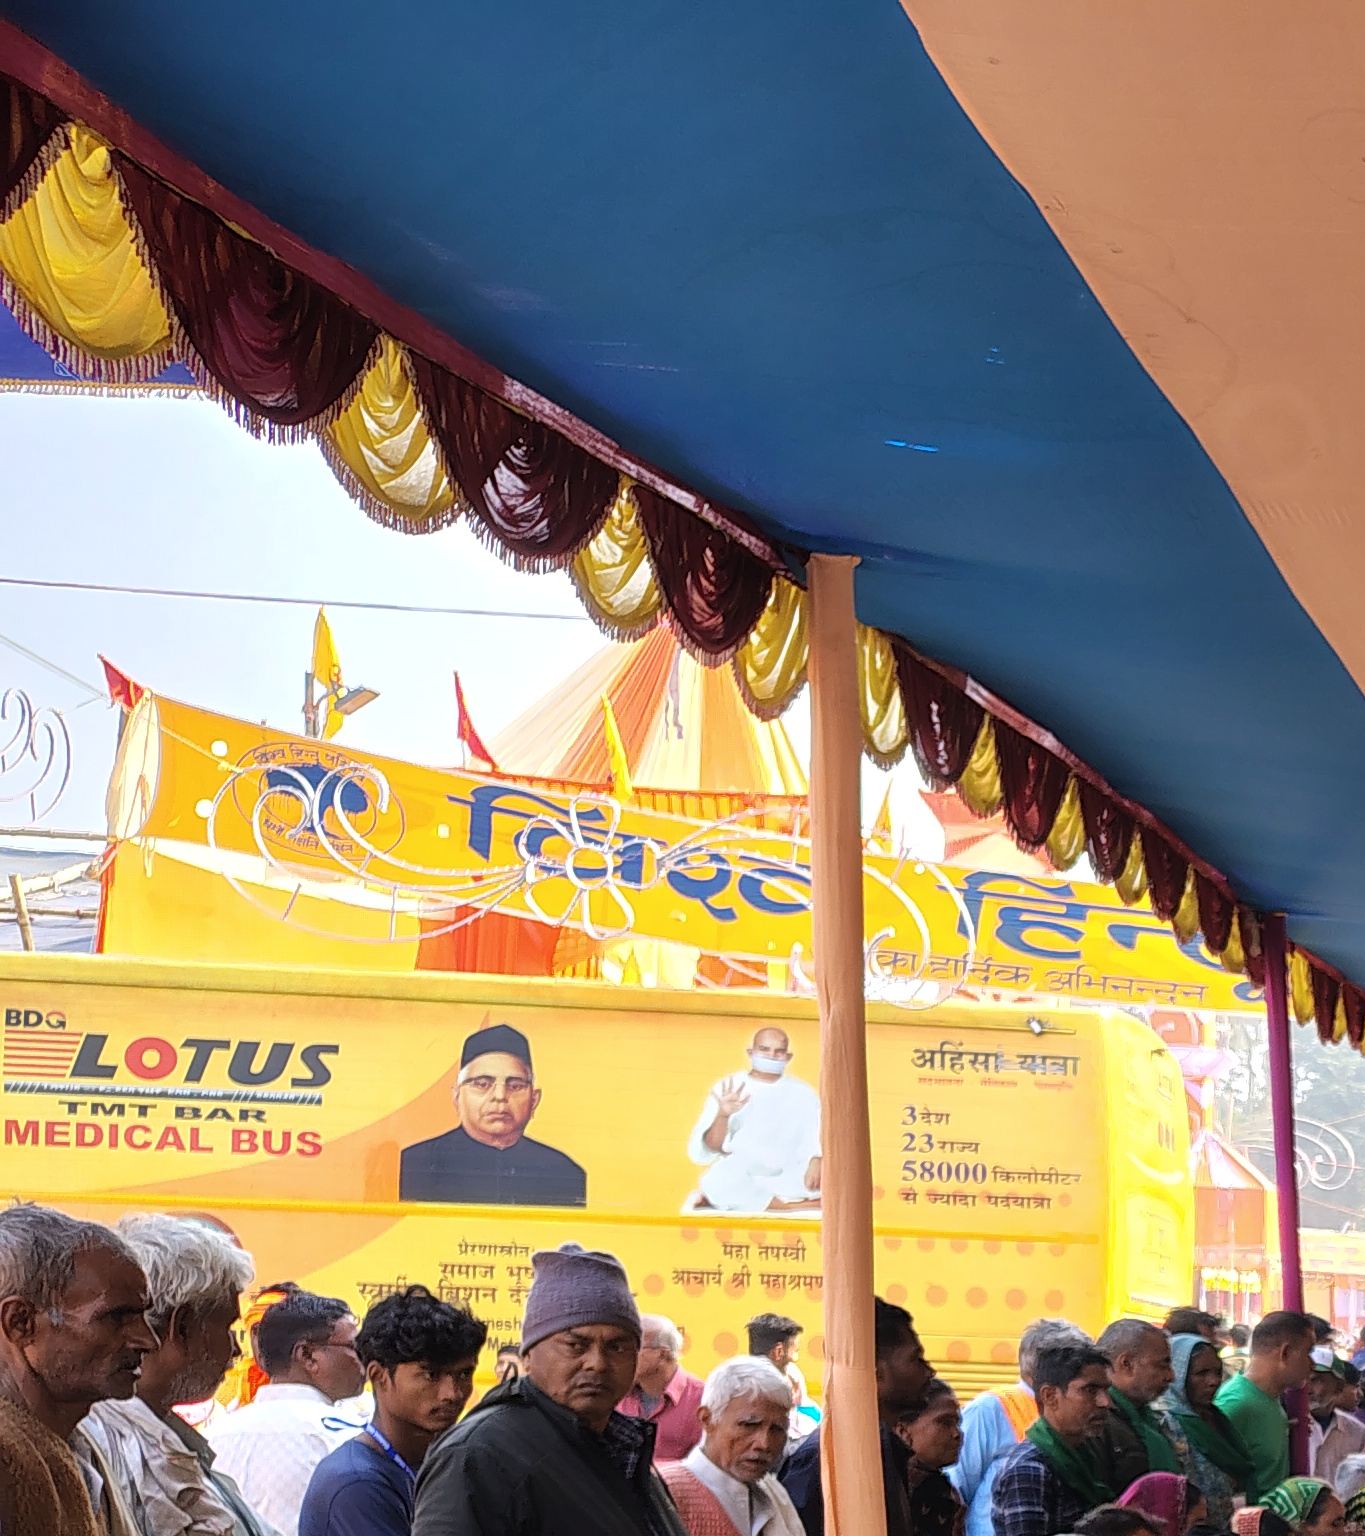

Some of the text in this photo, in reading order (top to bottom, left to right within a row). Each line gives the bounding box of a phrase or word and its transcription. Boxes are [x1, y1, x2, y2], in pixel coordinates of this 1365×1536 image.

[1044, 964, 1207, 1003] अभिनन्दन
[68, 1032, 340, 1088] LOTUS
[58, 1100, 267, 1123] TMT BAR
[901, 1105, 917, 1126] 3
[4, 1119, 324, 1158] MEDICAL BUS
[901, 1132, 935, 1154] 23
[901, 1159, 987, 1184] 58000
